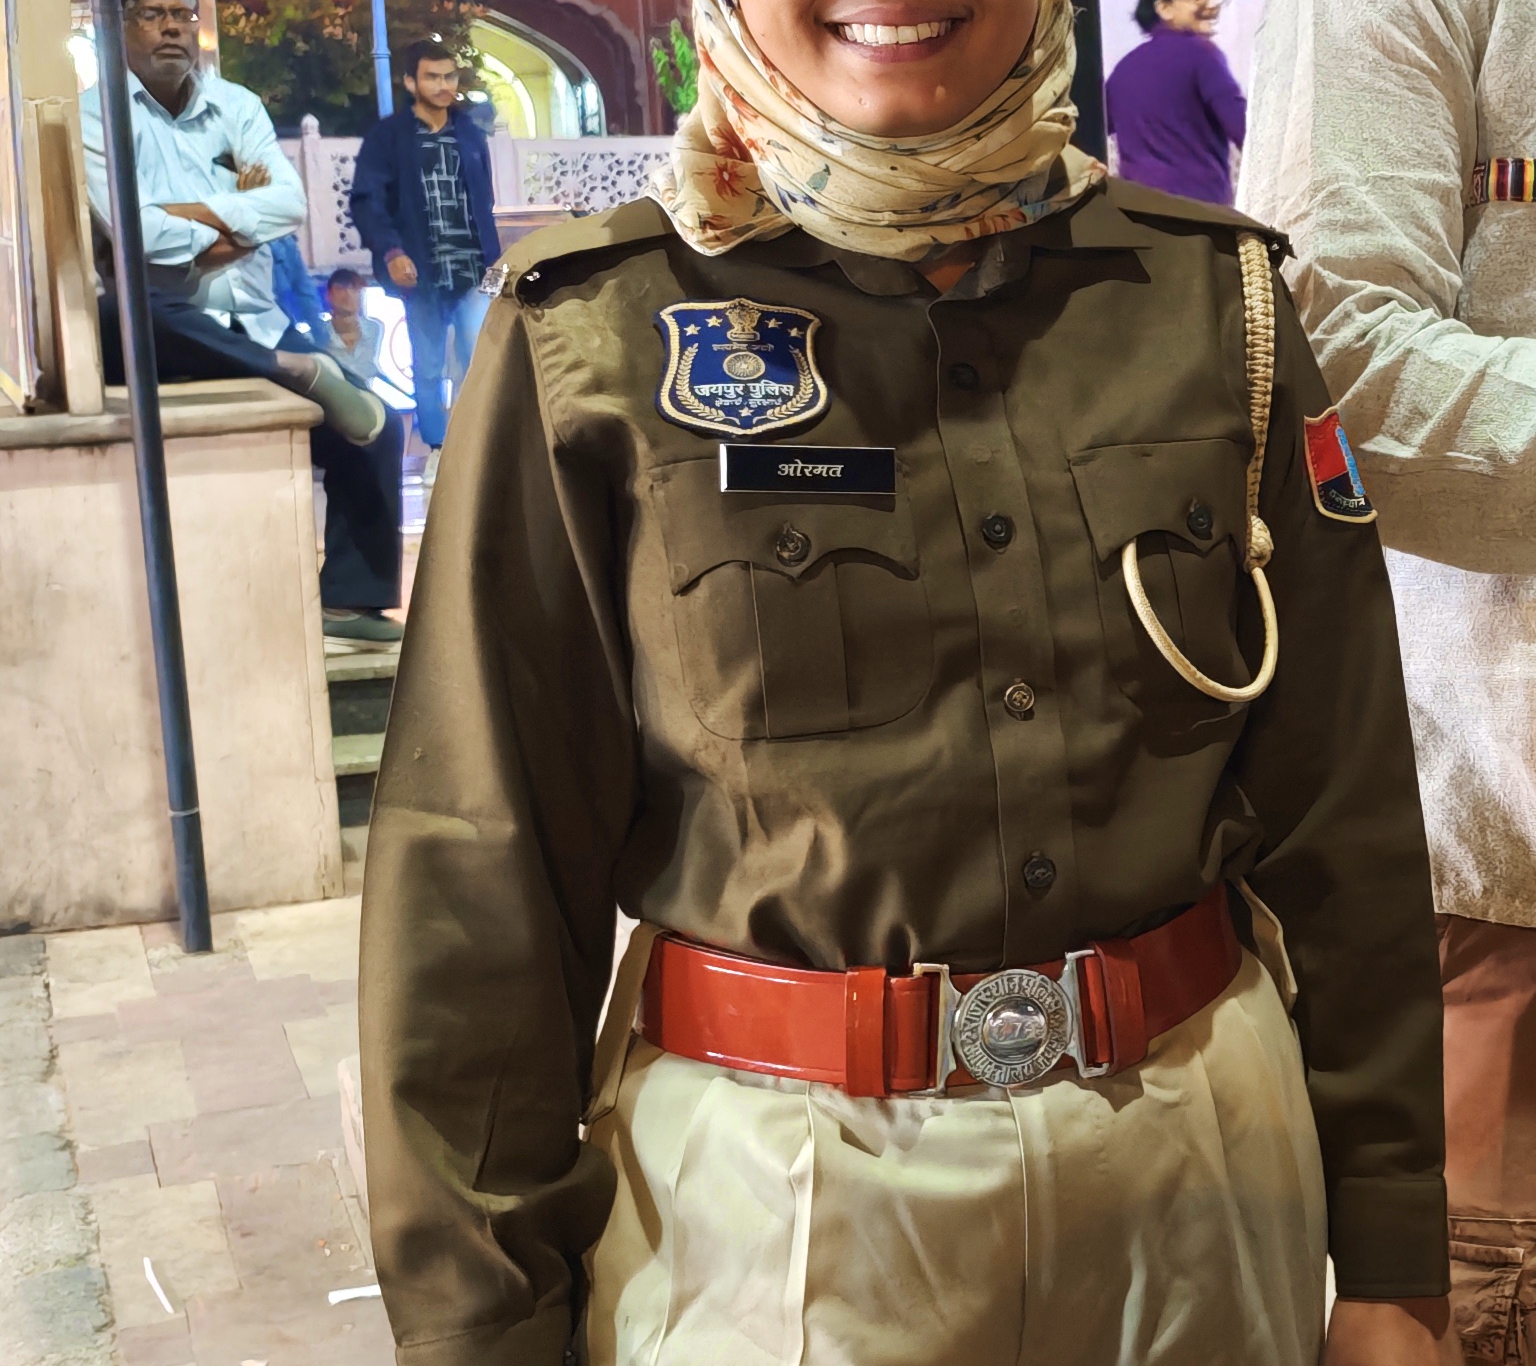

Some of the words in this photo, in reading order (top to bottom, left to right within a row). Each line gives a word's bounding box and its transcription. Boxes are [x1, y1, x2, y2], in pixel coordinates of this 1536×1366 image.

[693, 382, 746, 399] जयपुर
[746, 379, 795, 399] पुलिस
[777, 458, 845, 478] ओरमत
